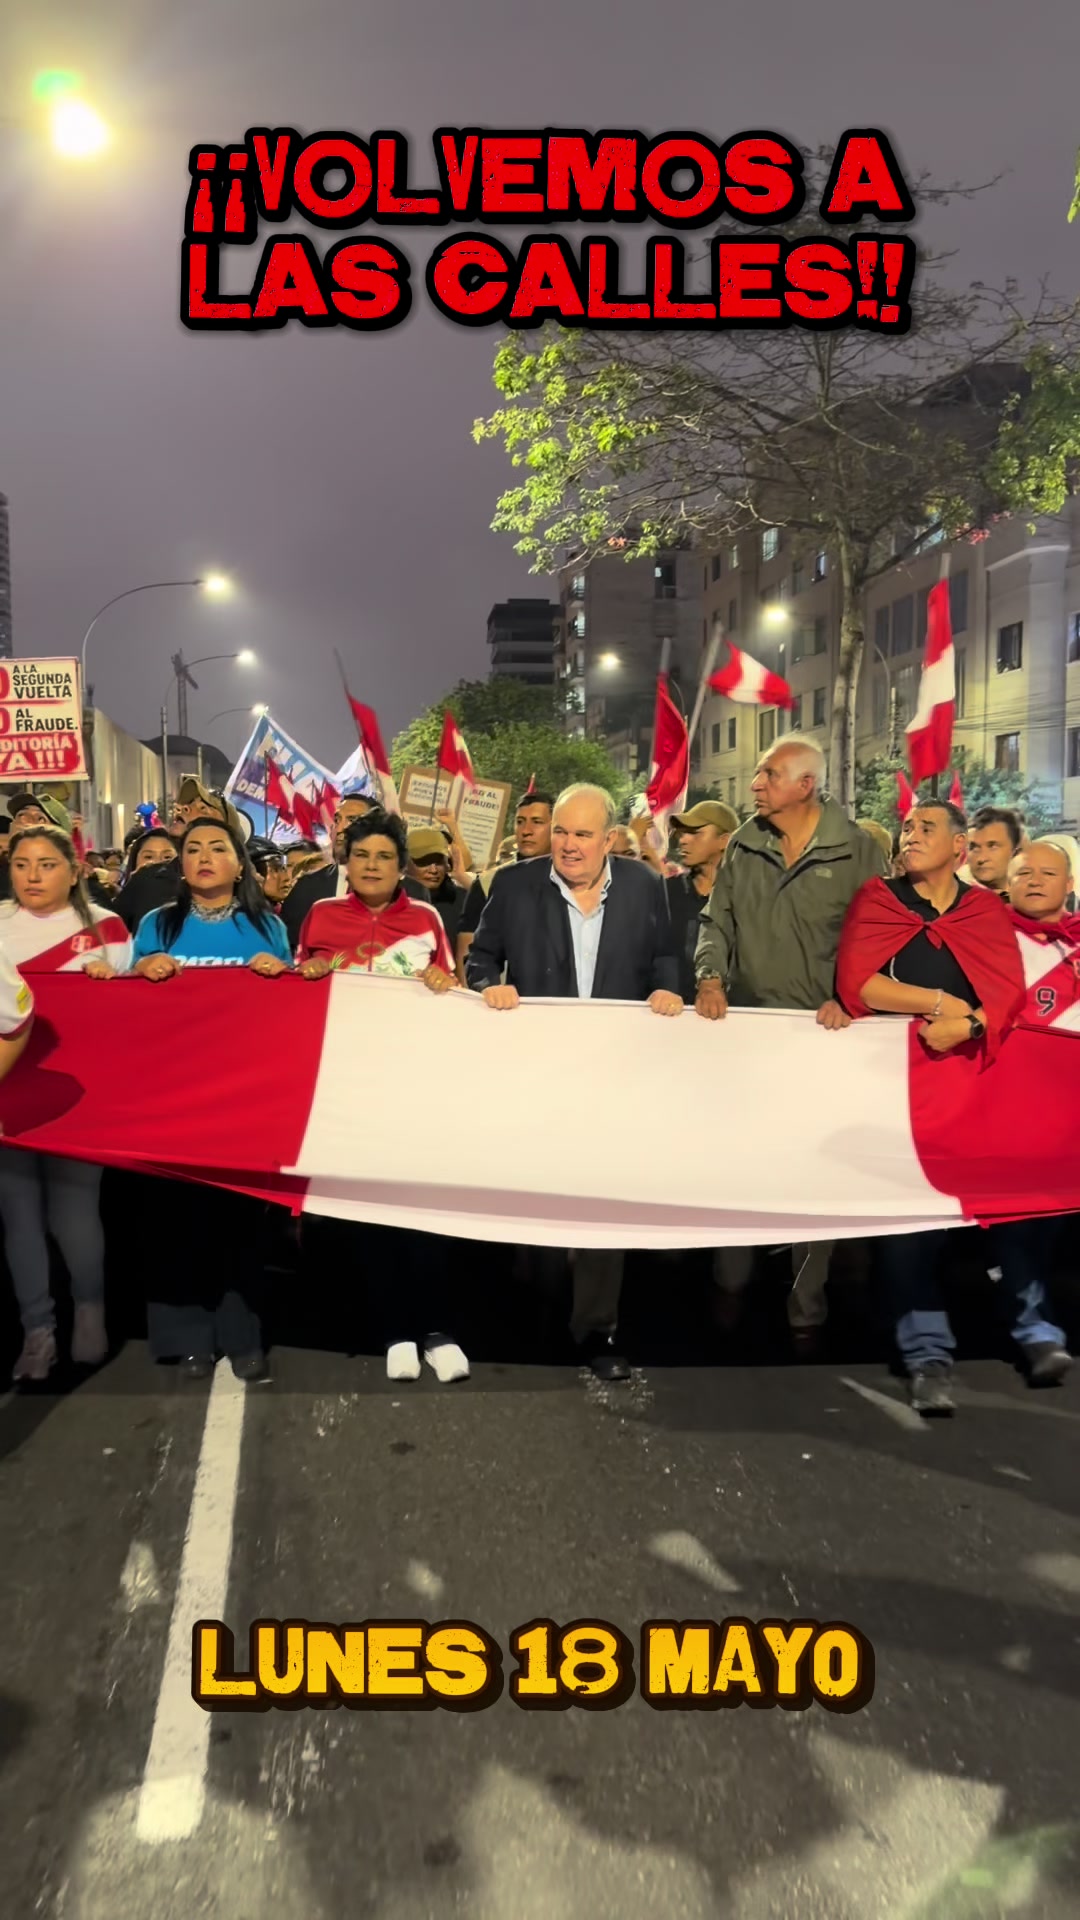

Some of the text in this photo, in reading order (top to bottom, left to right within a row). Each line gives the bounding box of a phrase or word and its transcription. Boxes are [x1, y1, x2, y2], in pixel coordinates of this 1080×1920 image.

[13, 664, 38, 674] A LA
[13, 673, 73, 686] SEGUNDA
[14, 685, 73, 699] VUELTA
[16, 708, 33, 718] AL
[16, 718, 78, 731] FRAUDE.
[1035, 986, 1057, 1017] 9
